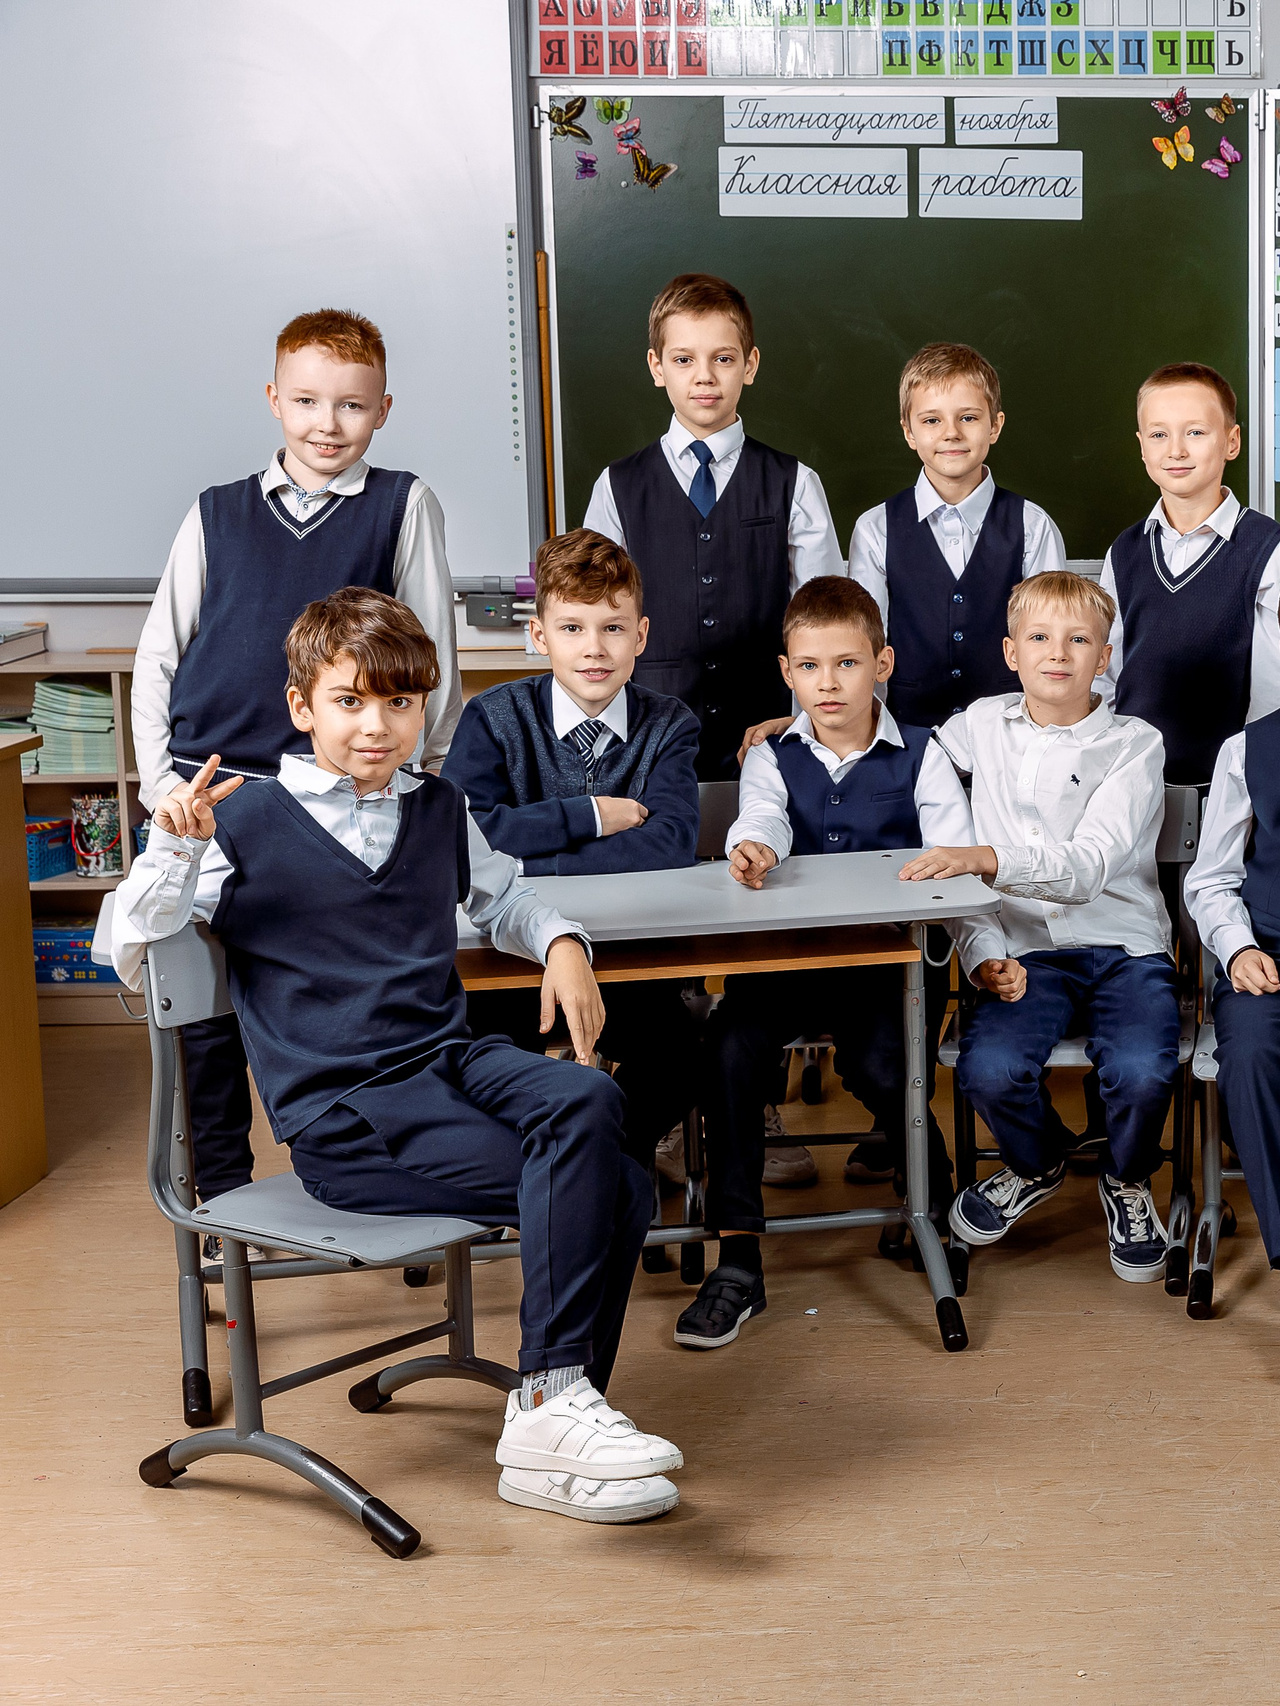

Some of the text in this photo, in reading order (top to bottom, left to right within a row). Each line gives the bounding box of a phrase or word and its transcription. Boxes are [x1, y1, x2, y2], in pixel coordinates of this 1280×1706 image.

[544, 34, 1245, 73] Я Ё Ю И Е П Ф К Т Ш С Х Ц Ч Щ Ь
[730, 98, 1053, 142] Пятнадцатое ноября
[725, 154, 1078, 212] Классная работа
